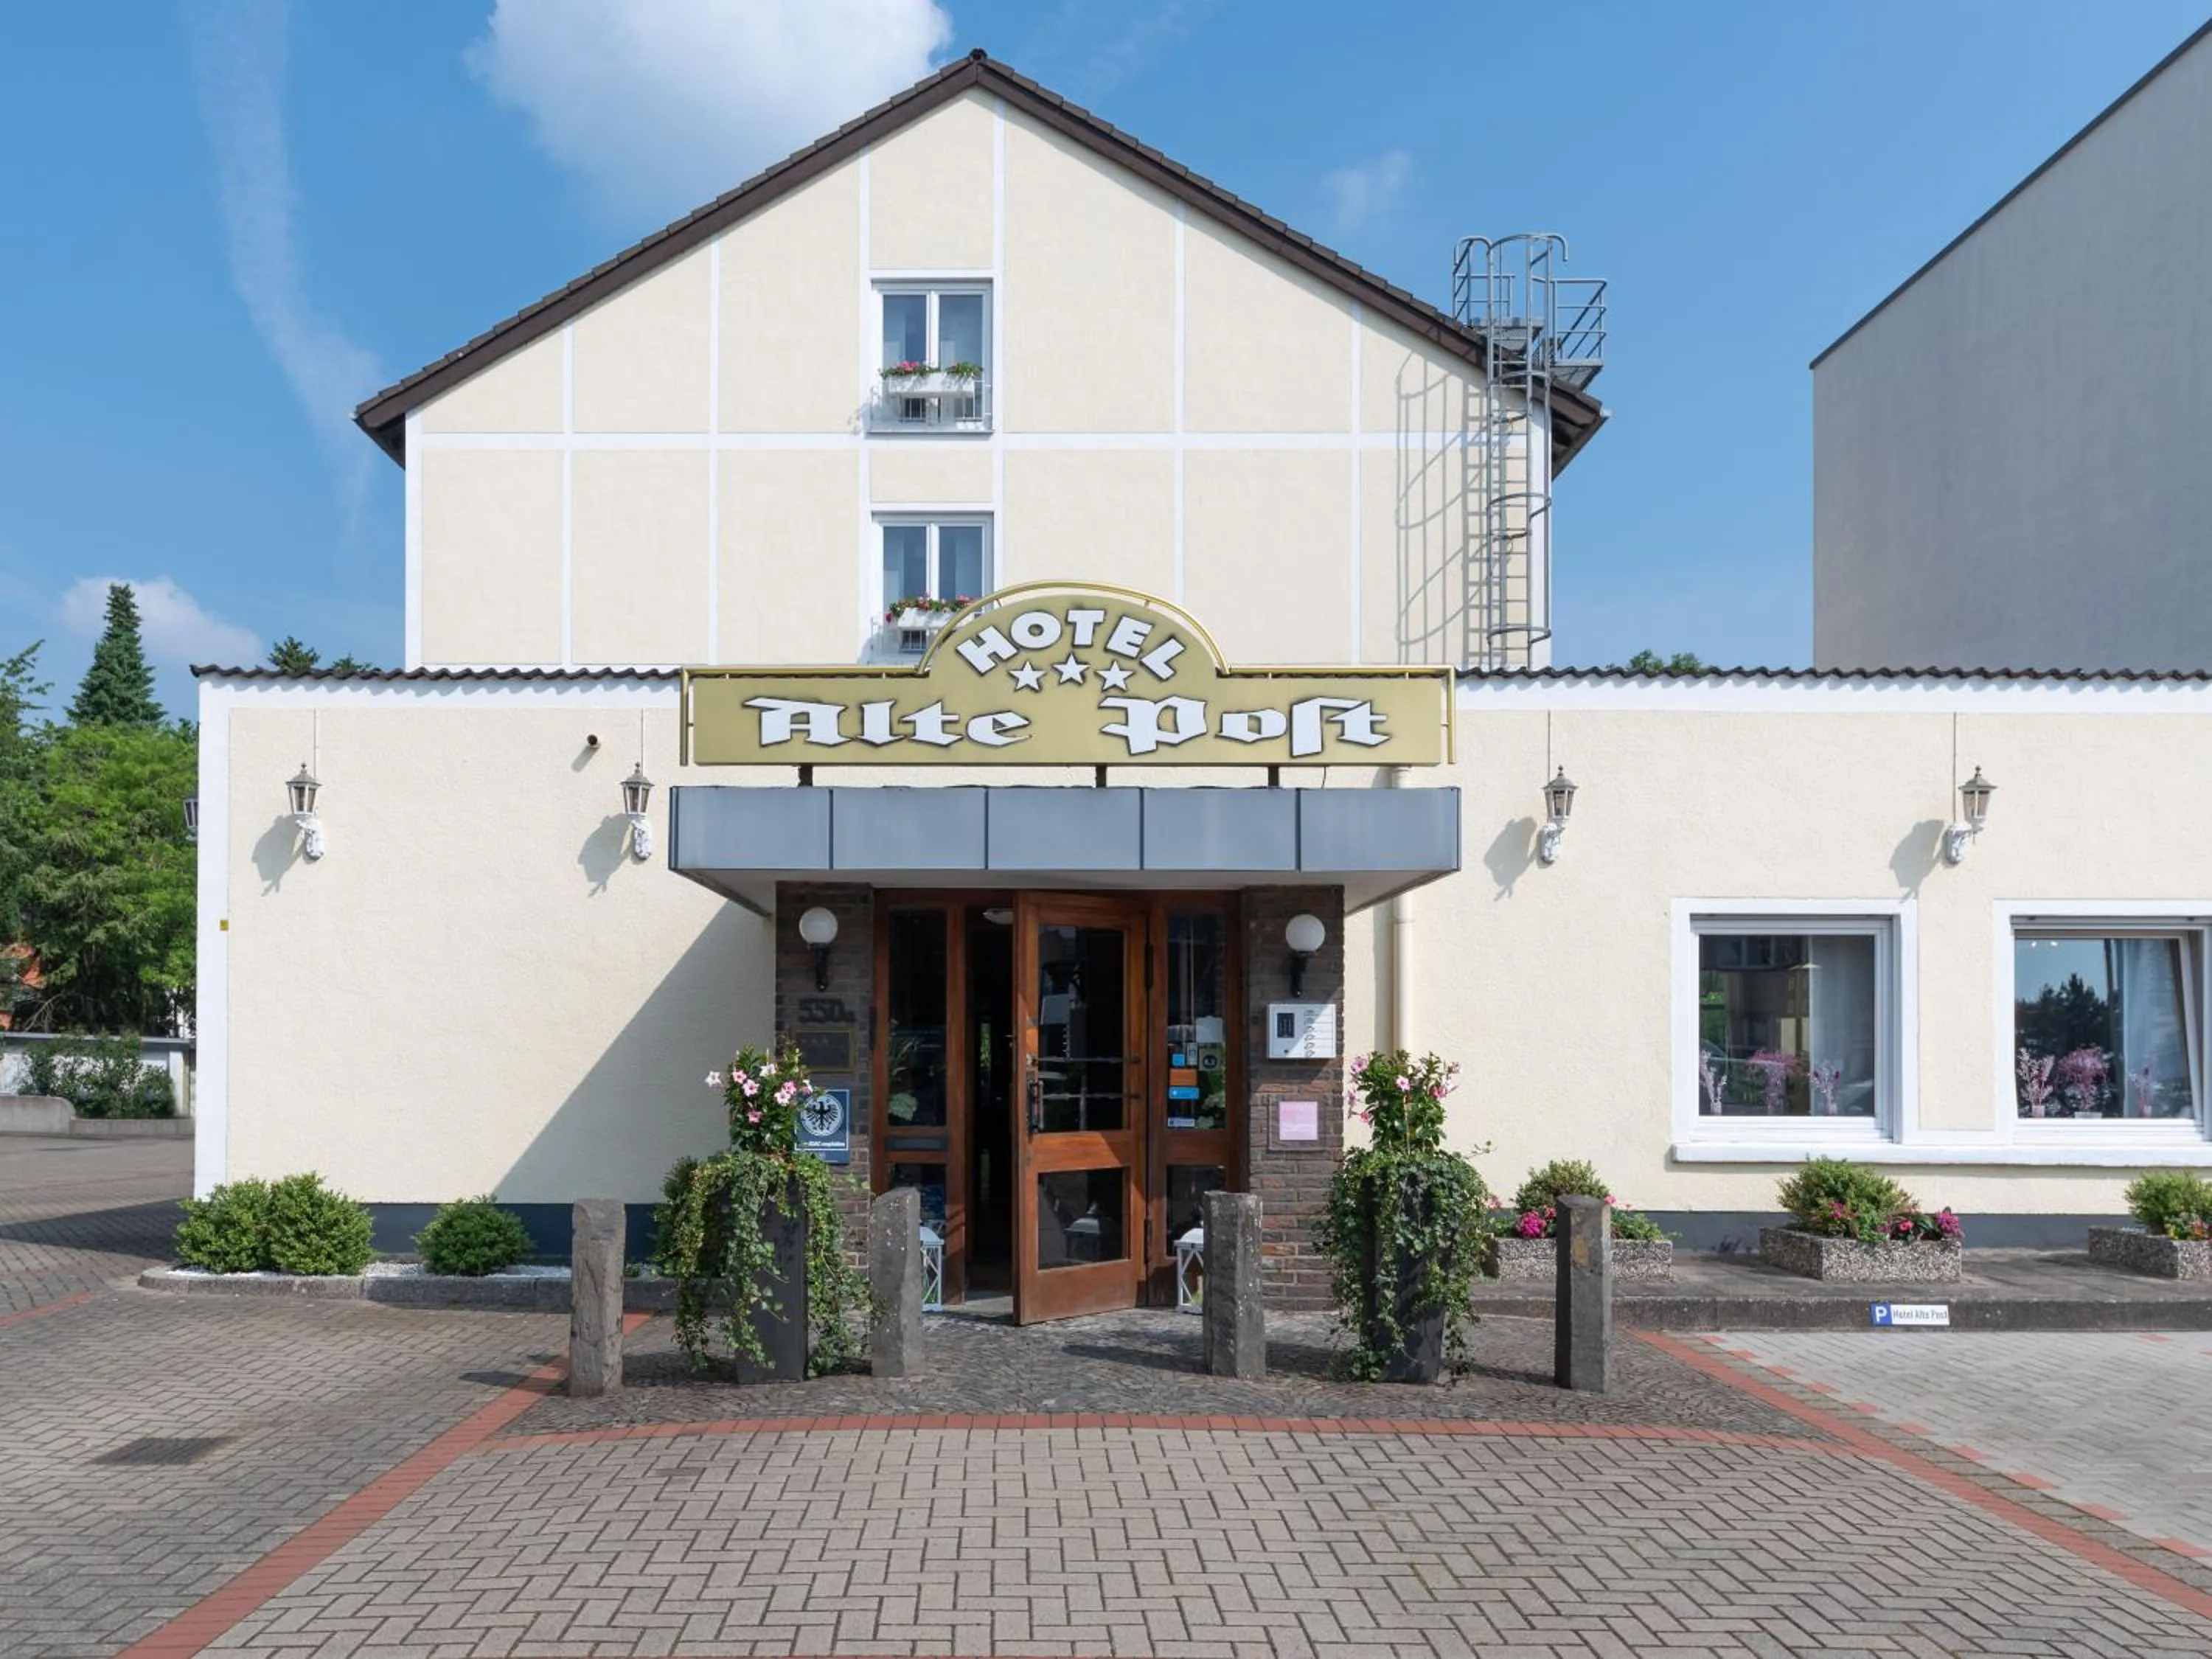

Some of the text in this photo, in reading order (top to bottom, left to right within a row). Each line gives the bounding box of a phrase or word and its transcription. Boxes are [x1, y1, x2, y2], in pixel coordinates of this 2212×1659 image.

[957, 610, 1185, 680] HOTEL
[742, 697, 1033, 747] Alte
[1875, 1306, 1888, 1322] P
